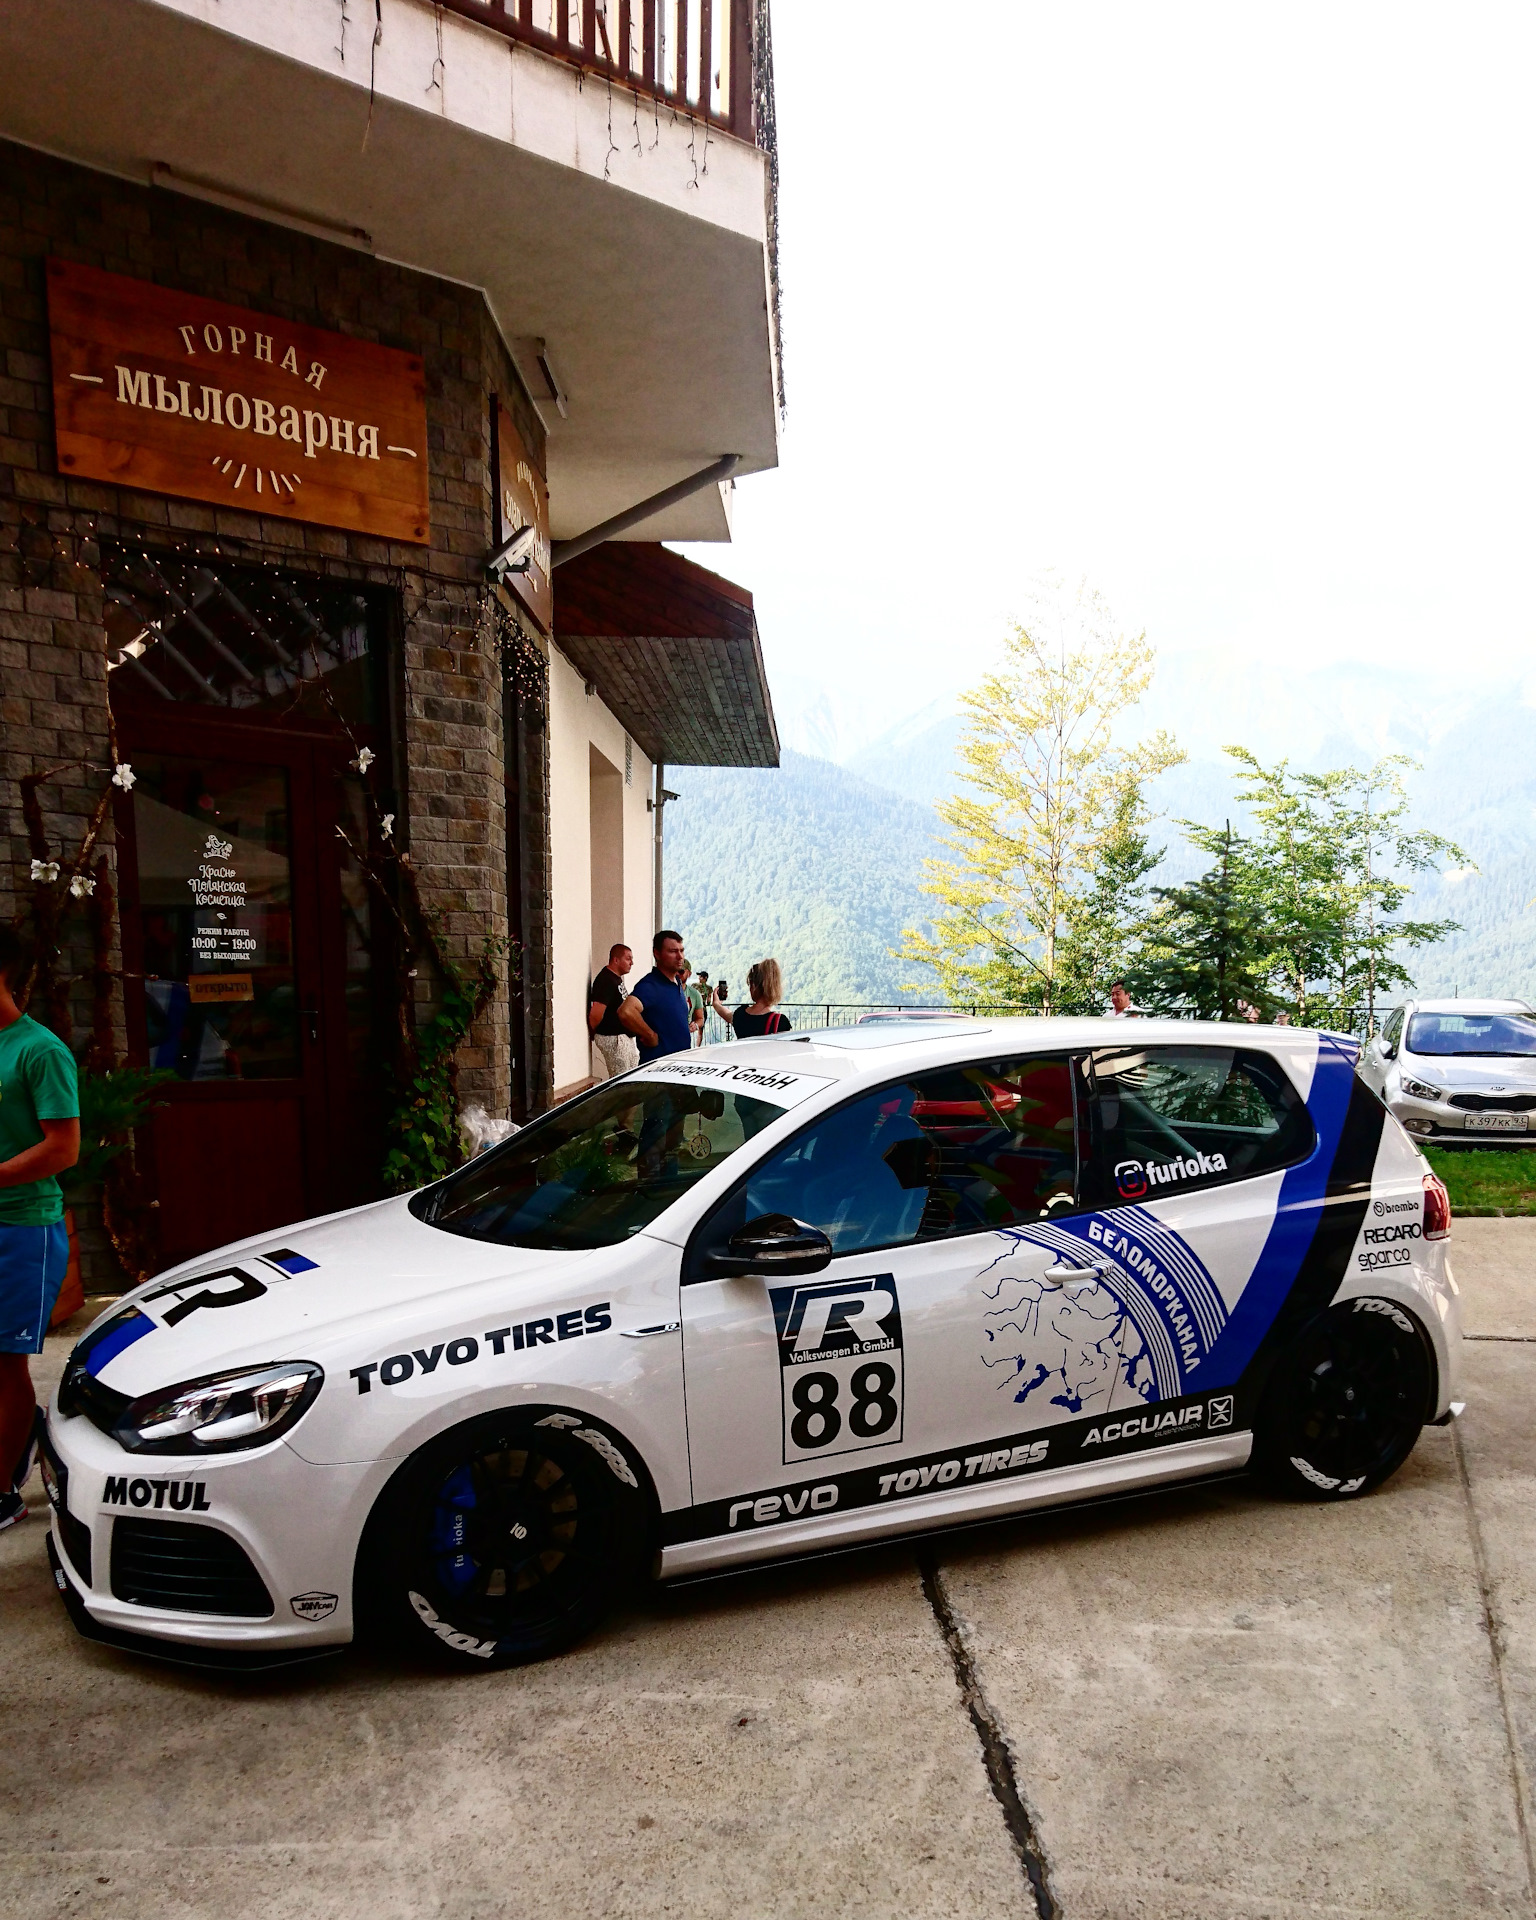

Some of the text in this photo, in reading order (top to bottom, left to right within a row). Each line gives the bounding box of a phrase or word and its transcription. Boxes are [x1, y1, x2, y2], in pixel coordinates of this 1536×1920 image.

[178, 323, 328, 391] ГОРНАЯ
[187, 878, 248, 894] Полянская
[199, 864, 236, 879] Красно
[191, 937, 217, 949] 10:00
[232, 938, 257, 950] 19:00
[197, 927, 250, 936] РЕЖИМ РАБОТЫ
[199, 951, 251, 961] БЕЗ ВЫХОДНЫХ
[716, 1065, 735, 1078] R
[732, 1068, 799, 1090] GmbH
[1146, 1151, 1228, 1186] furioka
[1385, 1201, 1419, 1214] brembo
[1364, 1223, 1422, 1245] RECARO
[1358, 1248, 1411, 1272] sparco
[1088, 1220, 1202, 1374] БЕЛОМОРКАНАЛ
[793, 1289, 895, 1352] R
[1352, 1298, 1415, 1334] TOYO
[349, 1302, 612, 1395] TOYO TIRES
[789, 1338, 895, 1364] Volkswagen R GmbH
[791, 1361, 898, 1450] 88
[1081, 1404, 1204, 1447] ACCUAIR
[878, 1440, 1050, 1497] TOYO TIRES
[102, 1476, 212, 1511] MOTUL
[729, 1484, 839, 1528] revo
[408, 1590, 498, 1659] TOYO
